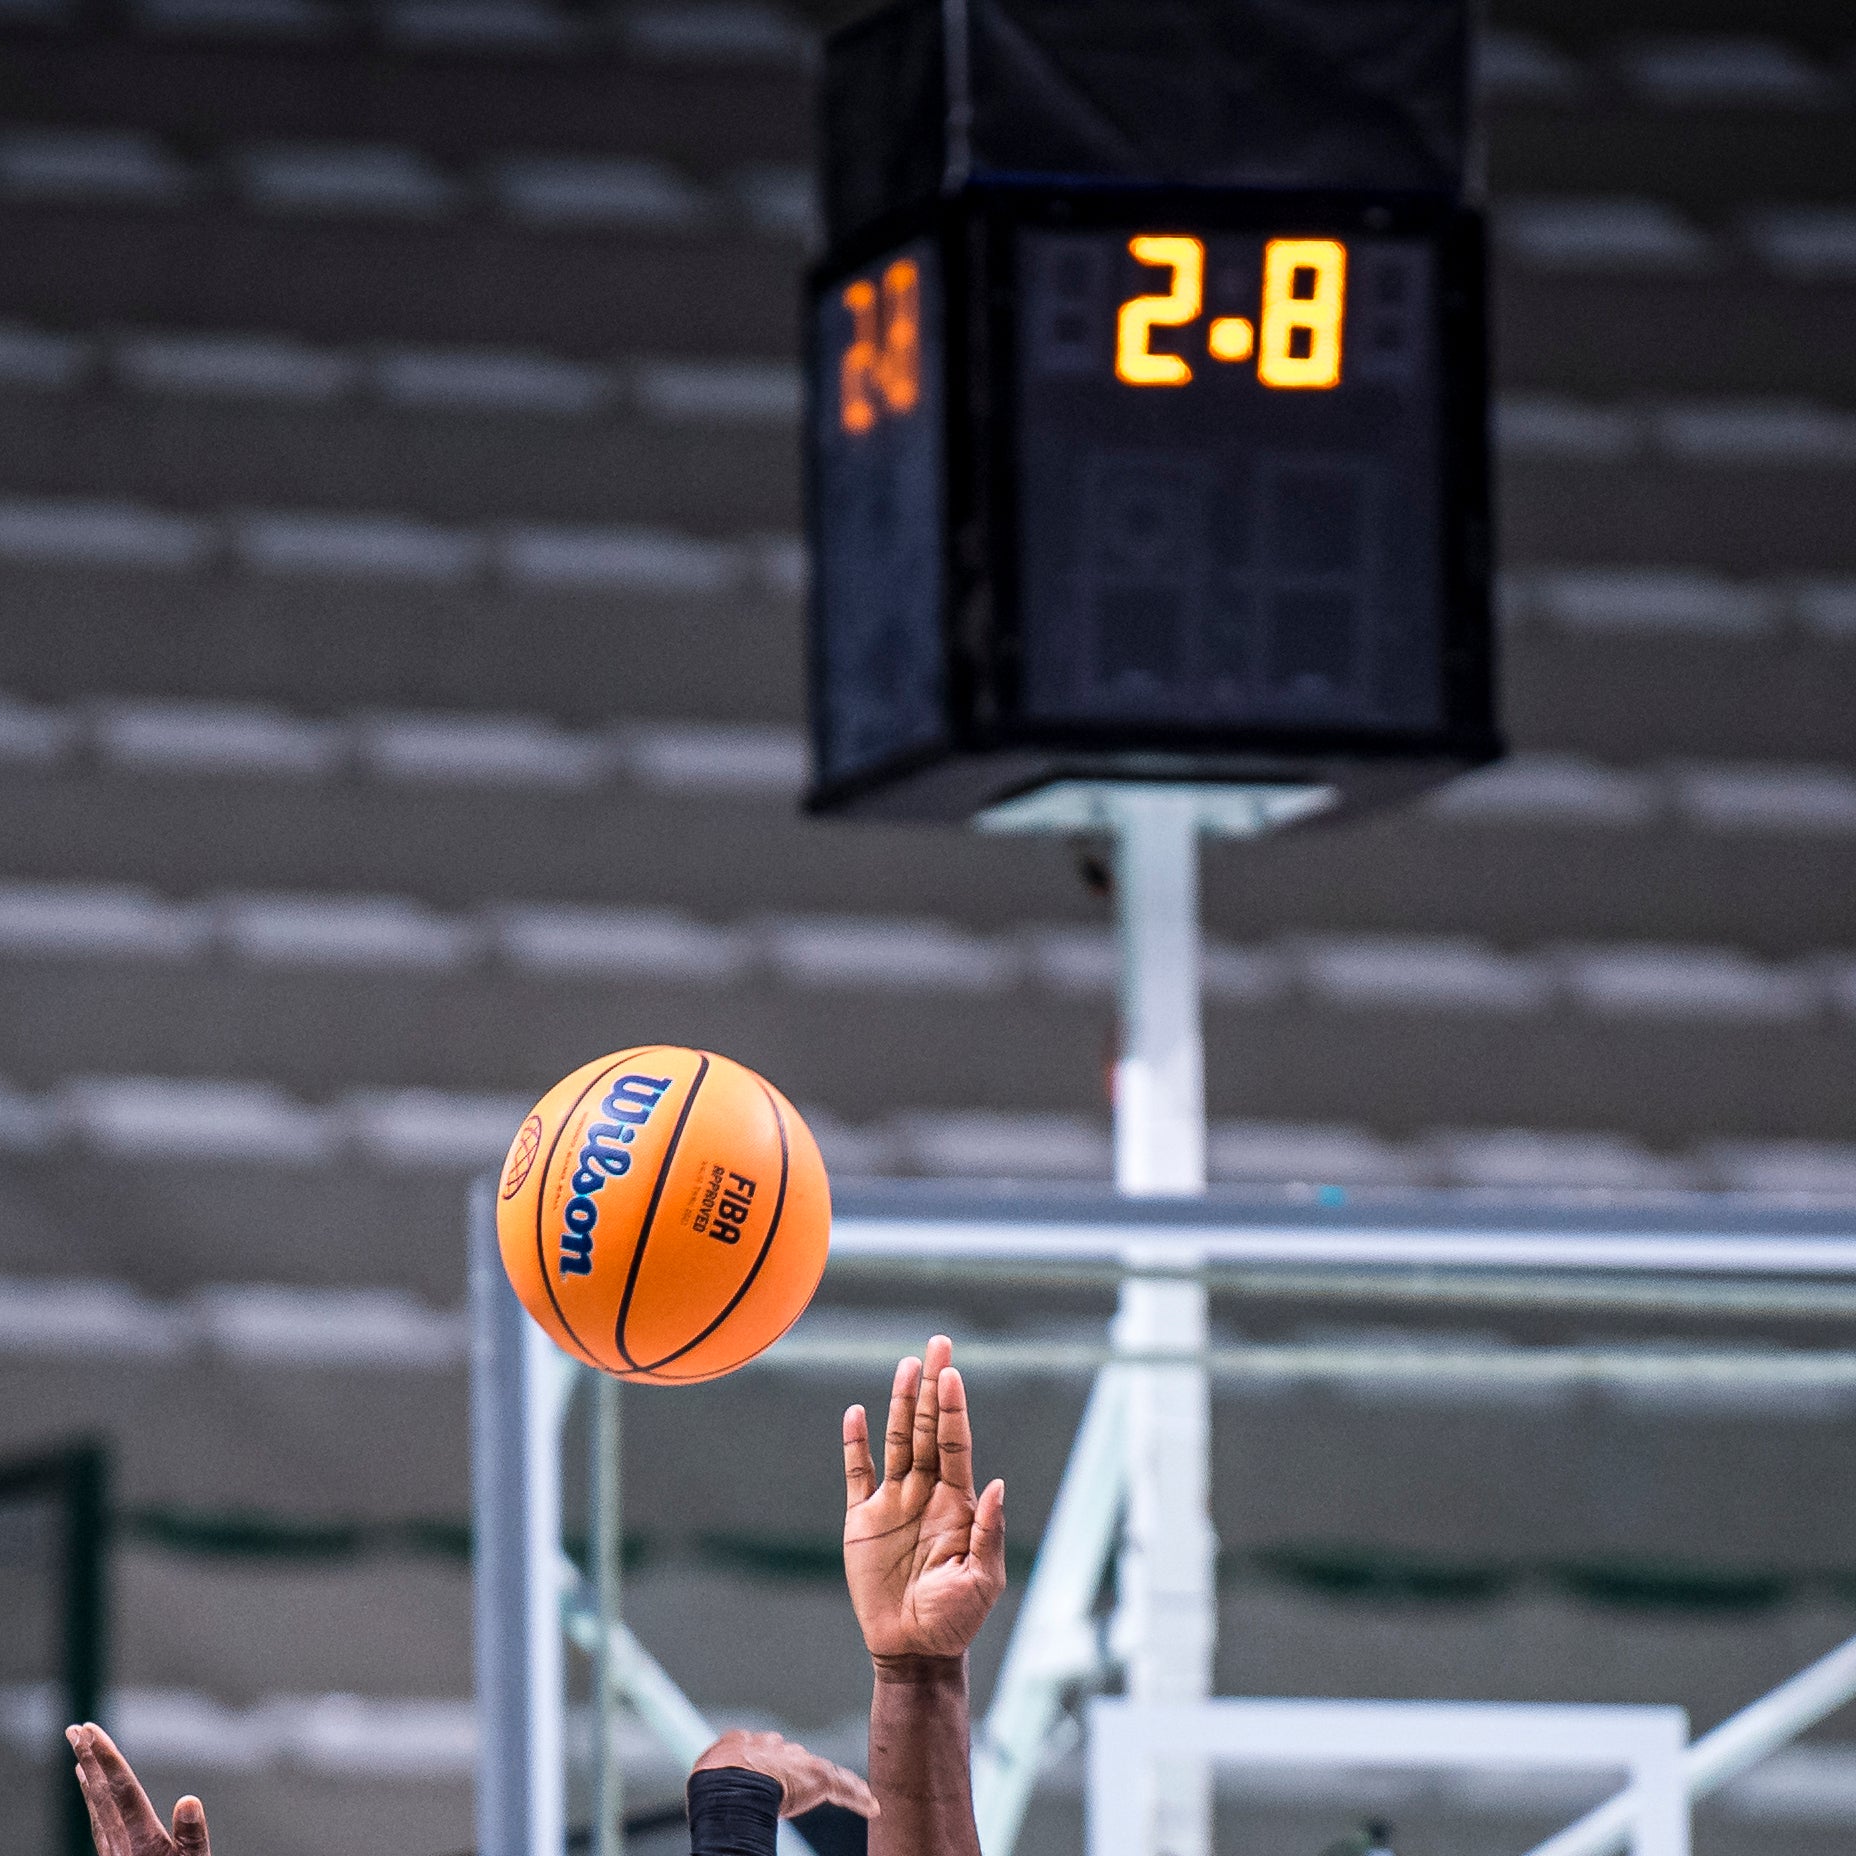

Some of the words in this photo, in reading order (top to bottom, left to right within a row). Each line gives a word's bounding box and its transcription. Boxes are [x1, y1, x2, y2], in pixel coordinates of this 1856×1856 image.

[1116, 234, 1347, 390] 2.8
[559, 1074, 673, 1277] Wilson
[692, 1165, 725, 1233] APPROVED
[708, 1171, 757, 1245] FIBA
